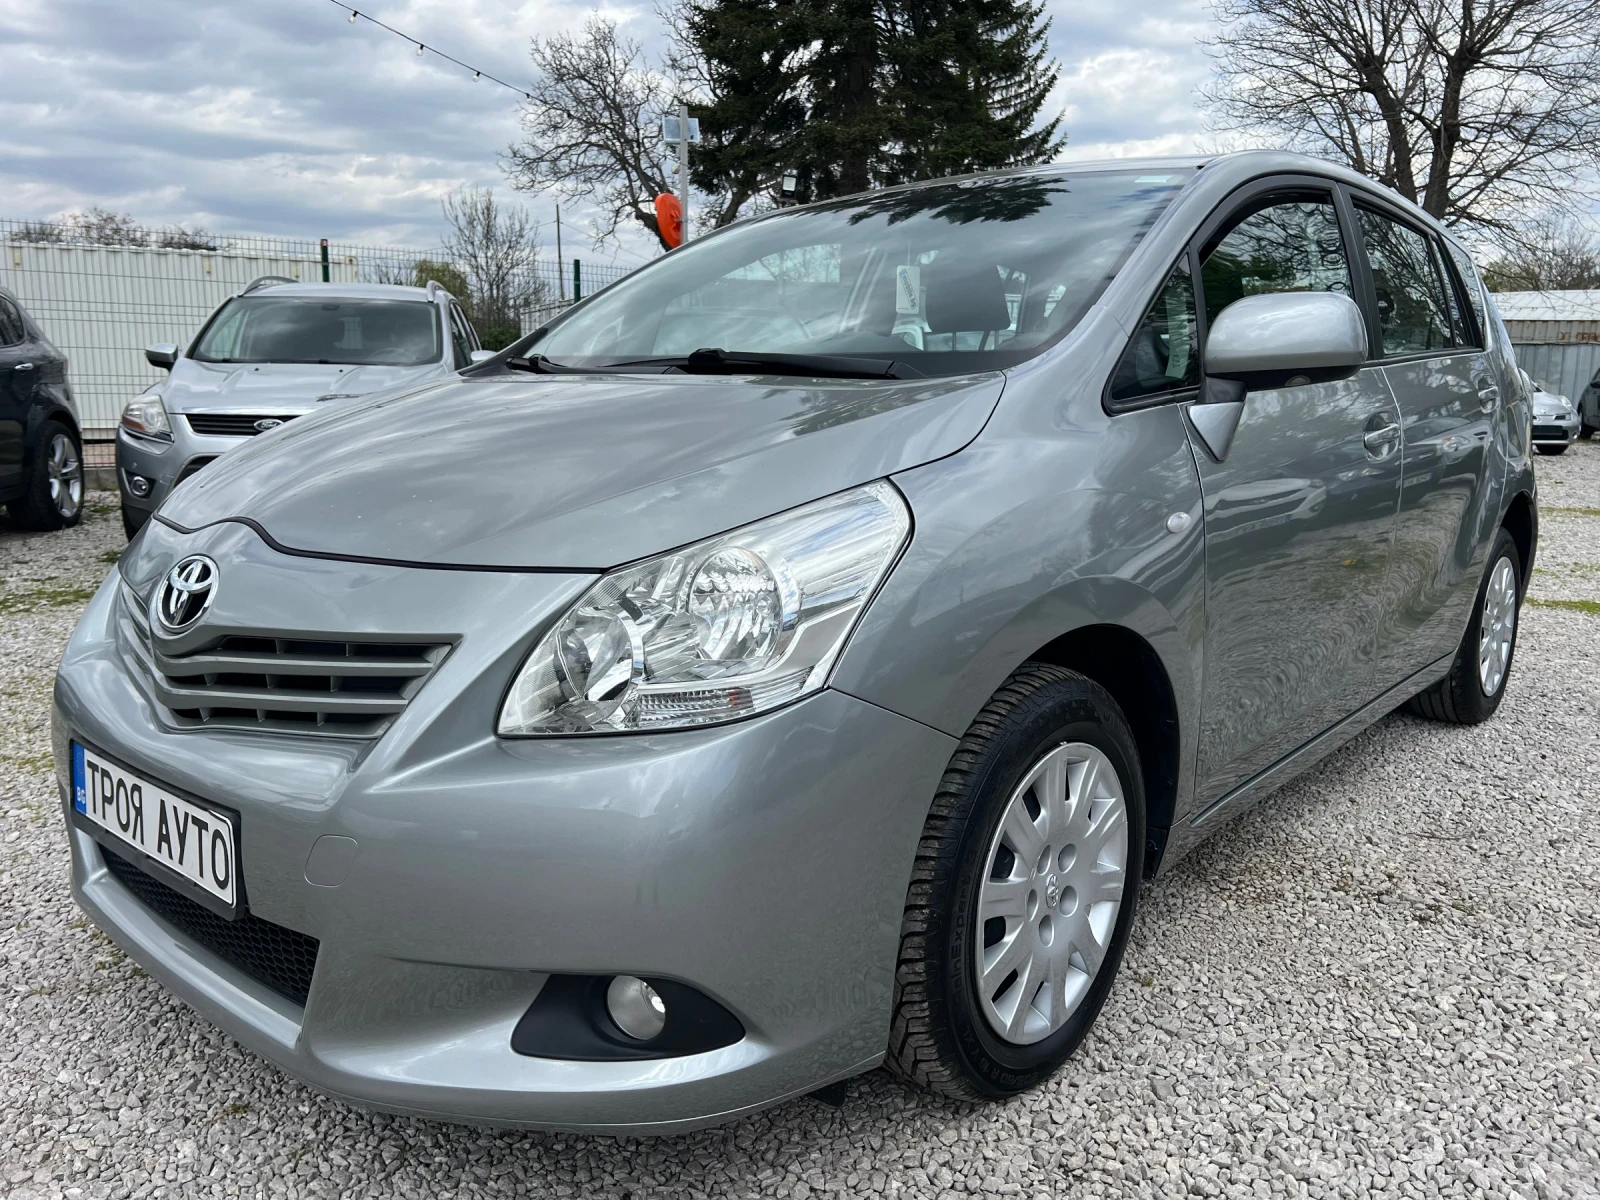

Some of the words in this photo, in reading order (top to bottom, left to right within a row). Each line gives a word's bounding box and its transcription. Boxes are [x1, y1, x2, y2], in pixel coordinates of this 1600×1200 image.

[77, 786, 86, 804] BG
[87, 759, 145, 846] ТРОЯ
[157, 798, 230, 890] АУТО
